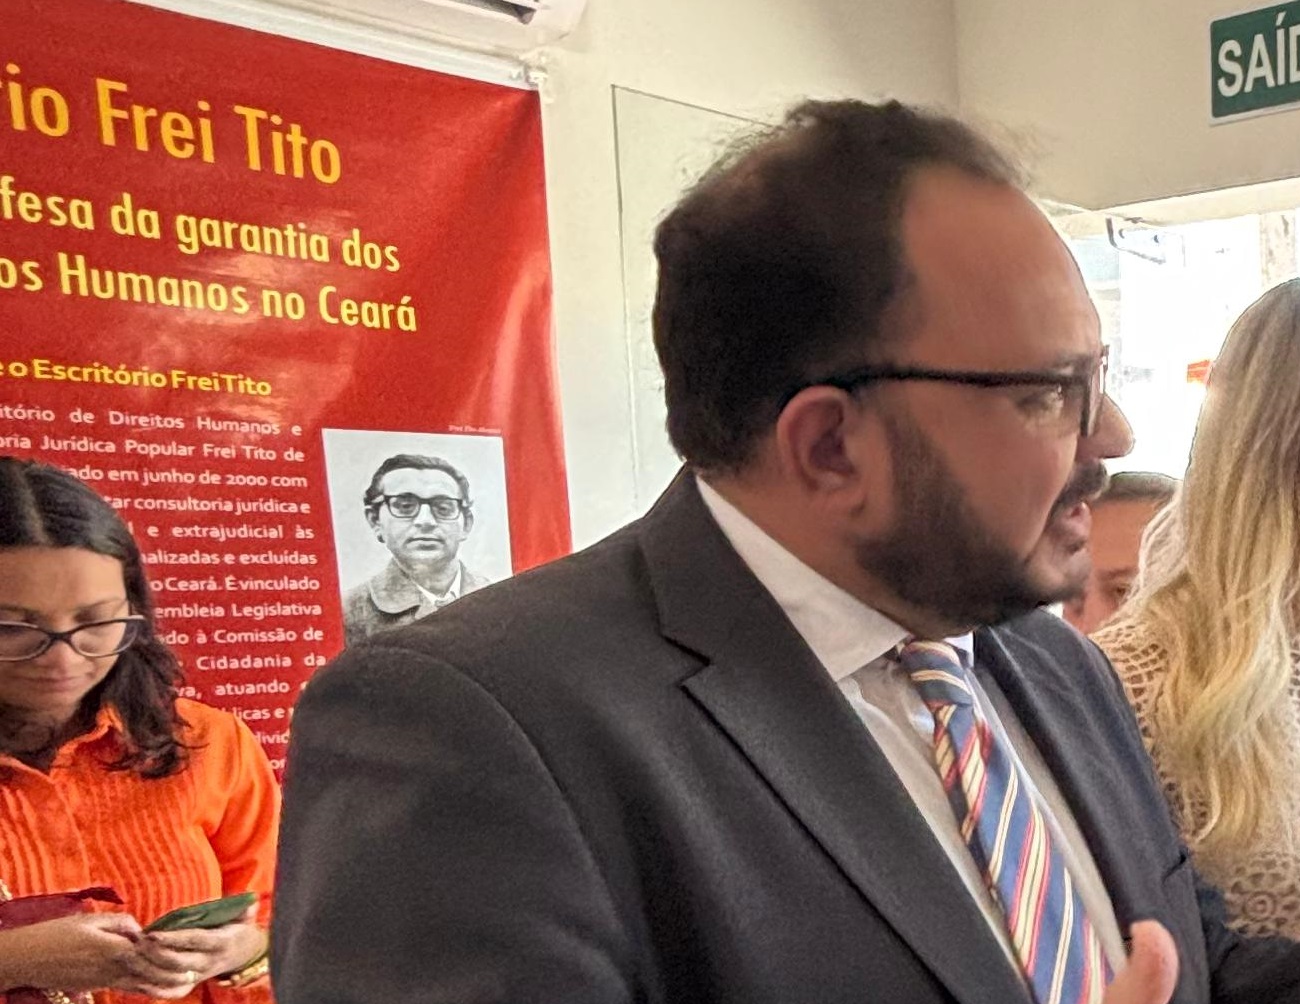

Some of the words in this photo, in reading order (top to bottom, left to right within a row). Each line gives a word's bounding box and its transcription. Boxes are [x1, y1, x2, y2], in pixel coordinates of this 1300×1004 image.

[0, 62, 70, 138] io
[96, 78, 215, 164] Frei
[233, 104, 341, 185] Tito
[111, 192, 161, 240] da
[175, 211, 330, 264] garantia
[342, 228, 401, 272] dos
[58, 252, 249, 315] Humanos
[263, 291, 304, 321] no
[319, 286, 417, 333] Ceará
[9, 363, 27, 377] o
[33, 359, 167, 388] Escritório
[69, 408, 95, 424] de
[109, 411, 185, 429] Direitos
[196, 416, 281, 435] Humanos
[291, 425, 303, 436] e
[40, 435, 116, 454] Jurídica
[124, 439, 195, 458] Popular
[203, 443, 237, 459] Frei
[242, 446, 276, 461] Tito
[284, 447, 305, 462] de
[108, 470, 139, 482] em
[142, 467, 195, 486] junho
[199, 471, 221, 485] de
[226, 475, 268, 486] 2000
[271, 476, 308, 488] com
[134, 496, 233, 512] consultoria
[235, 498, 298, 516] jurídica
[300, 503, 311, 514] e
[147, 526, 159, 537] e
[171, 524, 283, 542] extrajudicial
[295, 524, 314, 539] às
[224, 554, 236, 565] e
[239, 550, 317, 566] excluídas
[239, 576, 320, 591] vinculado
[232, 602, 322, 620] Legislativa
[196, 629, 207, 644] à
[213, 628, 297, 644] Comissão
[303, 627, 324, 641] de
[196, 655, 292, 670] Cidadania
[304, 652, 326, 667] da
[214, 679, 290, 696] atuando
[273, 707, 285, 719] e
